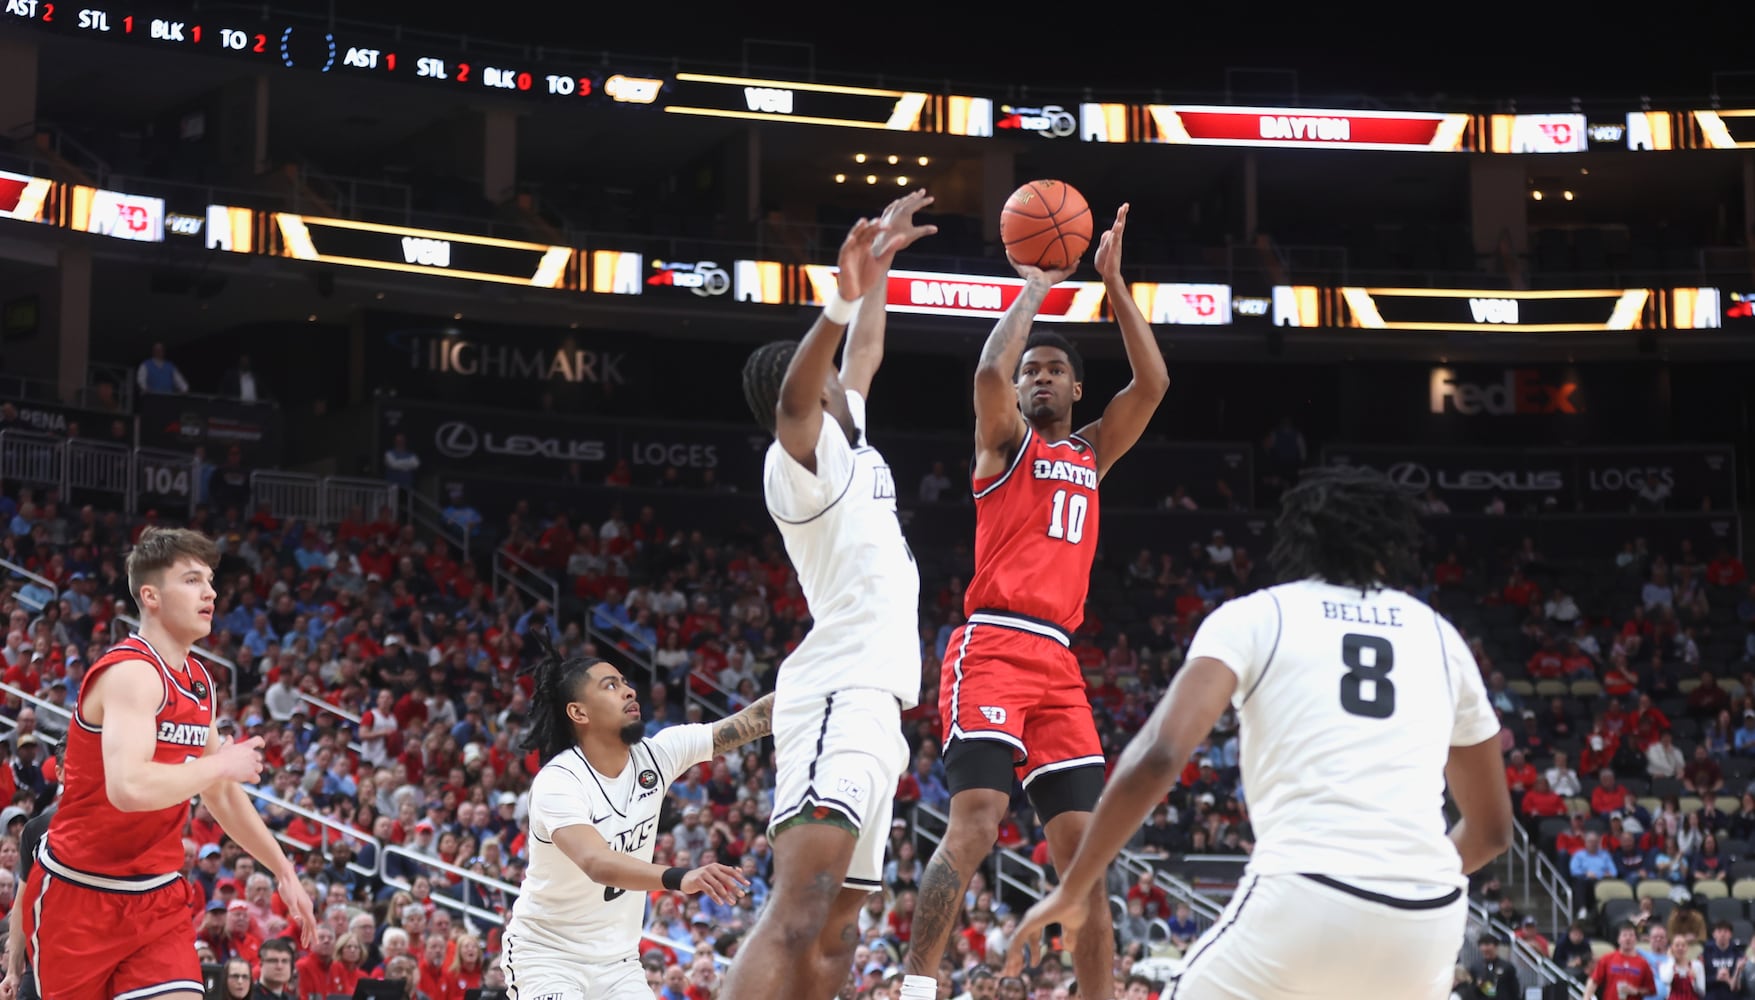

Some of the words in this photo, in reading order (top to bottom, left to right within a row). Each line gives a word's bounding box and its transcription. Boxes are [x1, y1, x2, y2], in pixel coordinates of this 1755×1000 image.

[5, 0, 38, 18] AST
[43, 4, 55, 22] 2
[77, 9, 111, 32] STL
[123, 15, 133, 34] 1
[150, 19, 185, 42] BLK
[191, 25, 202, 44] 1
[219, 29, 248, 50] TO
[253, 34, 267, 53] 2
[343, 47, 380, 69] AST
[386, 53, 396, 71] 1
[416, 57, 448, 79] STL
[456, 63, 470, 82] 2
[483, 66, 516, 90] BLK
[517, 72, 532, 91] 0
[546, 75, 575, 95] TO
[578, 77, 592, 97] 3
[744, 87, 793, 114] VCU
[1259, 115, 1351, 141] DAYTON
[402, 236, 450, 267] VCU
[910, 281, 1002, 309] DAYTON
[1468, 298, 1519, 324] VCU
[410, 335, 626, 385] HIGHMARK
[1429, 367, 1578, 415] FedEx
[484, 433, 606, 461] LEXUS
[632, 442, 718, 467] LOGES
[145, 465, 189, 495] 104
[1436, 470, 1564, 490] LEXUS
[1047, 488, 1089, 545] 10
[1322, 601, 1403, 627] BELLE
[1340, 633, 1396, 720] 8
[157, 721, 210, 747] DAYTO
